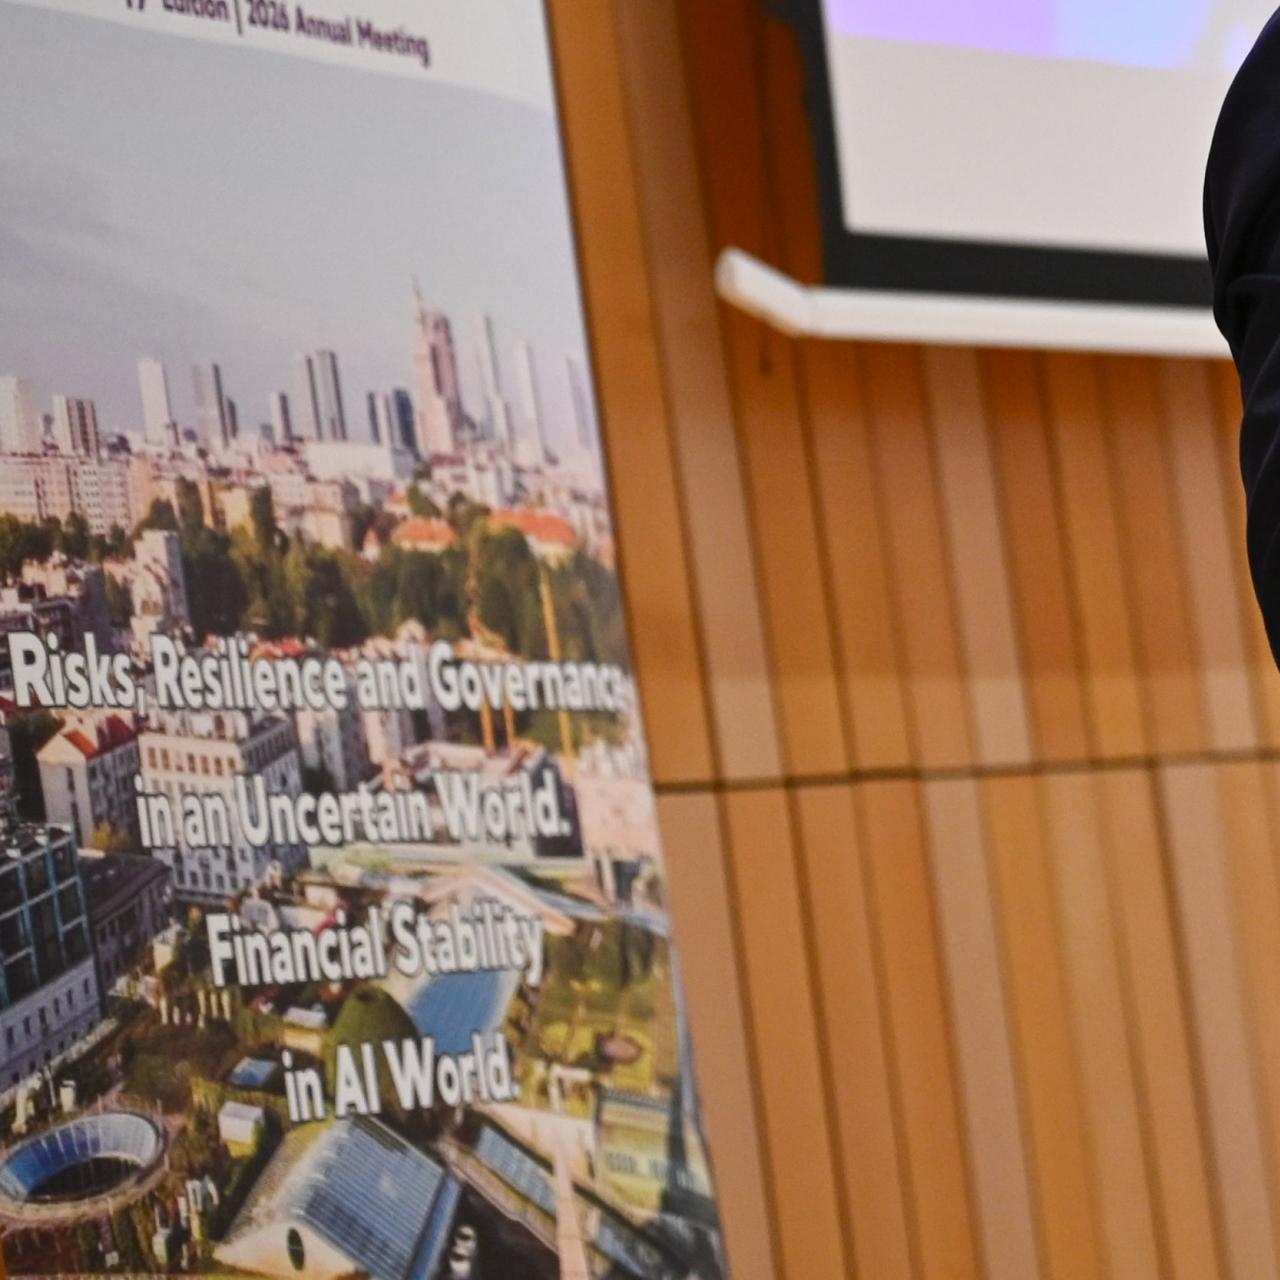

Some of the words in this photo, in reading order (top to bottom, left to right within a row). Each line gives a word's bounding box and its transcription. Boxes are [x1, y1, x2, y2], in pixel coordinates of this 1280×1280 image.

[295, 4, 352, 45] Annual
[354, 18, 431, 69] Meeting
[8, 630, 147, 717] Risks,
[151, 631, 348, 710] Resilience
[357, 644, 423, 710] and
[135, 773, 175, 848] in
[183, 792, 231, 847] an
[233, 775, 432, 846] Uncertain
[436, 770, 572, 840] World.
[205, 910, 389, 987] Financial
[391, 894, 544, 984] Stability
[284, 1049, 325, 1122] in
[335, 1042, 379, 1119] AI
[382, 1032, 521, 1112] World.
